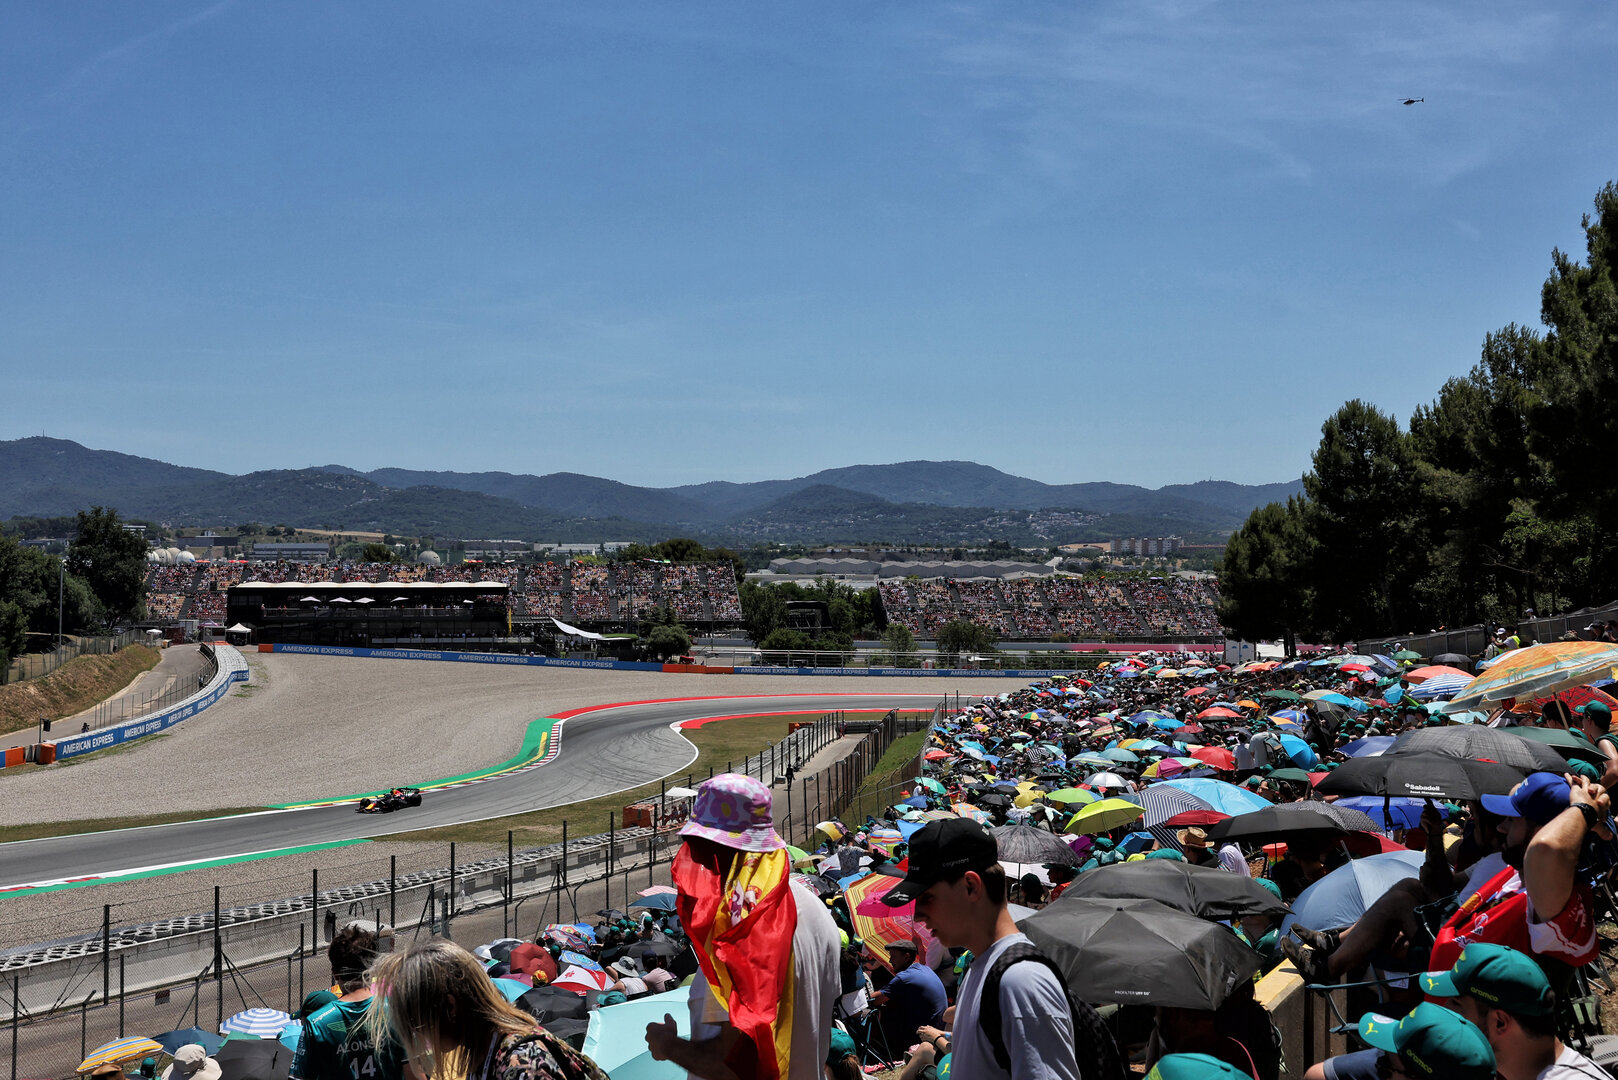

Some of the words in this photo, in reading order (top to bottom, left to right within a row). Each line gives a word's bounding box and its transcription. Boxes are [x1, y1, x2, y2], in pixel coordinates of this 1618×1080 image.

[281, 645, 319, 653] AMERICAN
[321, 647, 354, 655] EXPRESS
[370, 650, 408, 658] AMERICAN
[458, 654, 495, 662] AMERICAN
[496, 656, 529, 664] EXPRESS
[123, 725, 145, 739] AMERICAN
[145, 720, 162, 733] EXPRESS
[62, 739, 92, 755] AMERICAN
[92, 733, 114, 748] EXPRESS
[1470, 986, 1499, 1002] aramco
[349, 1055, 377, 1080] 14
[1406, 1048, 1433, 1074] aramco
